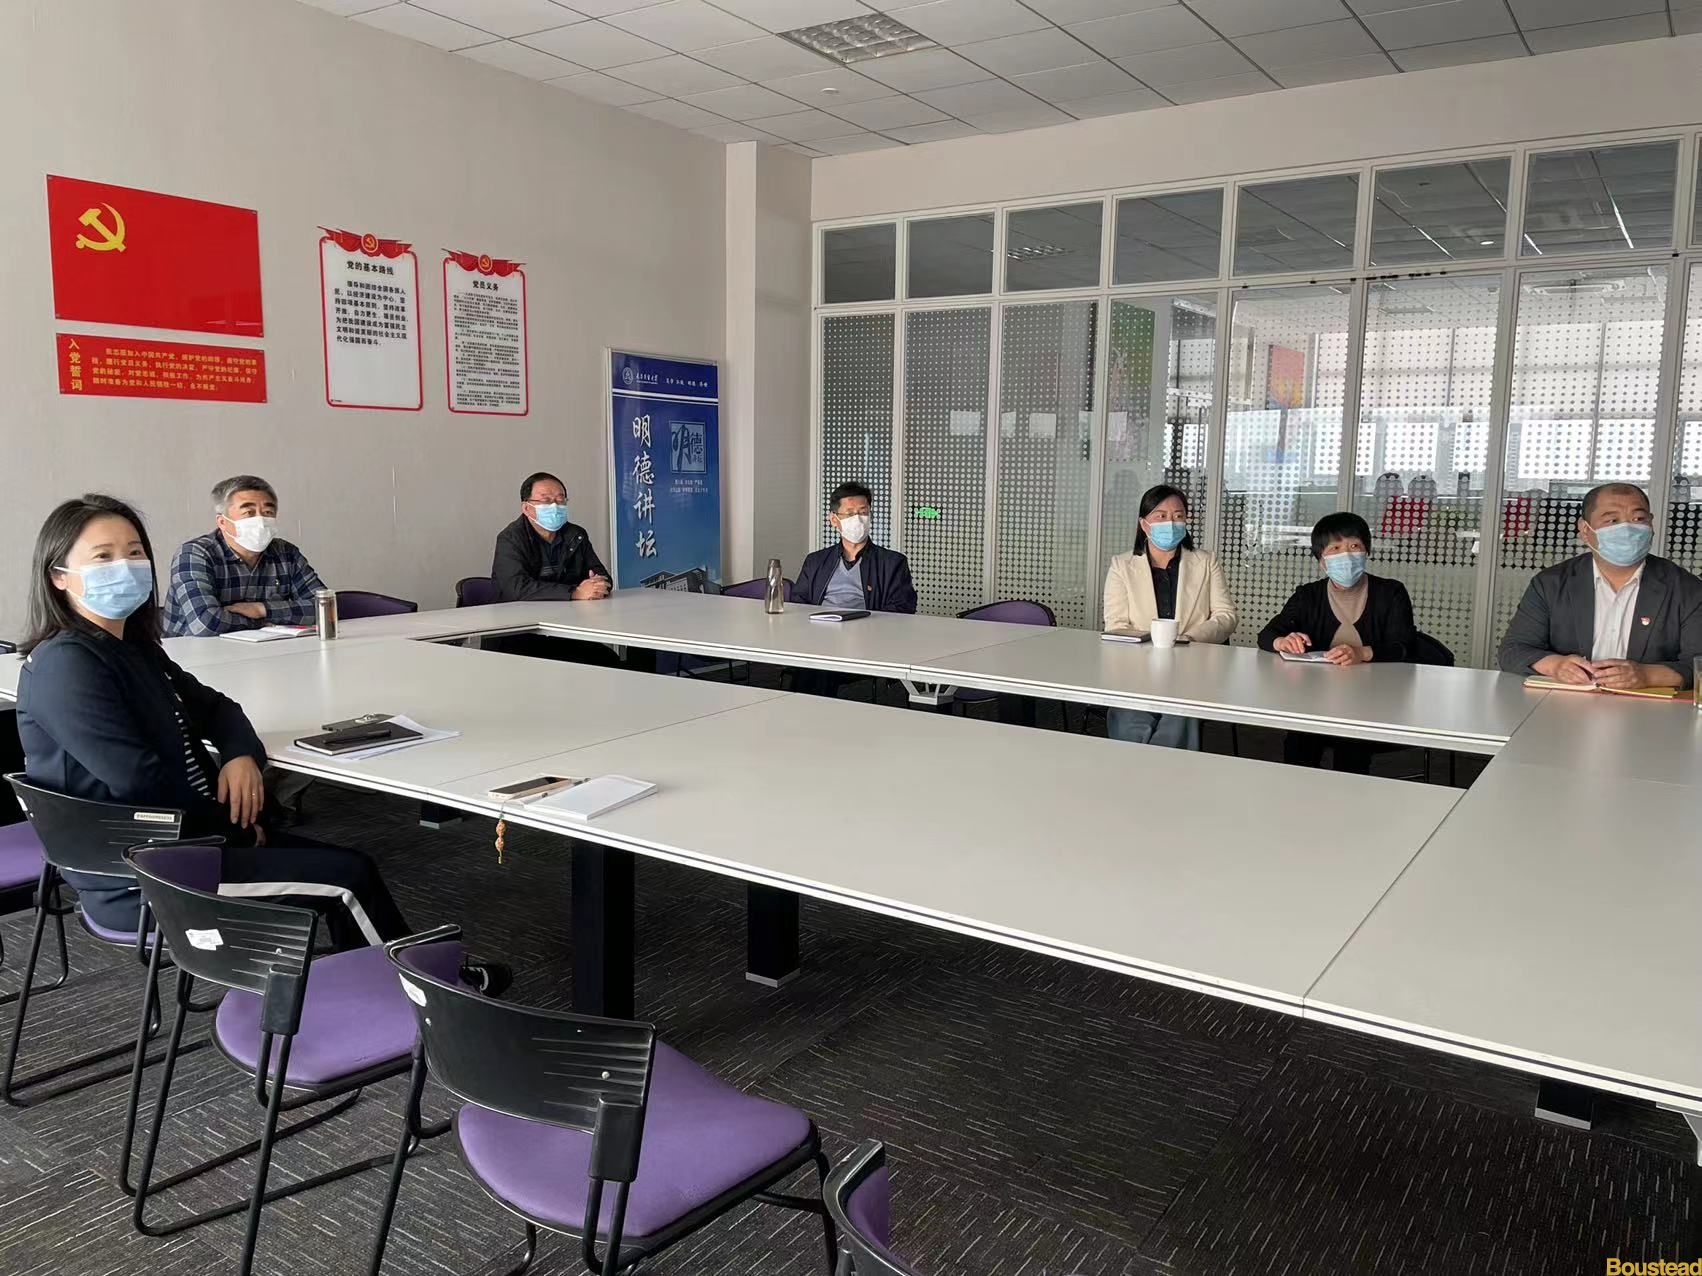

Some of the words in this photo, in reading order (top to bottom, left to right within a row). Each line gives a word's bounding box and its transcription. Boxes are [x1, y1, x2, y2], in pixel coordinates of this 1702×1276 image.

[346, 260, 394, 276] 党的基本路线
[68, 338, 83, 391] 入党誓词
[632, 414, 657, 557] 明德讲坛
